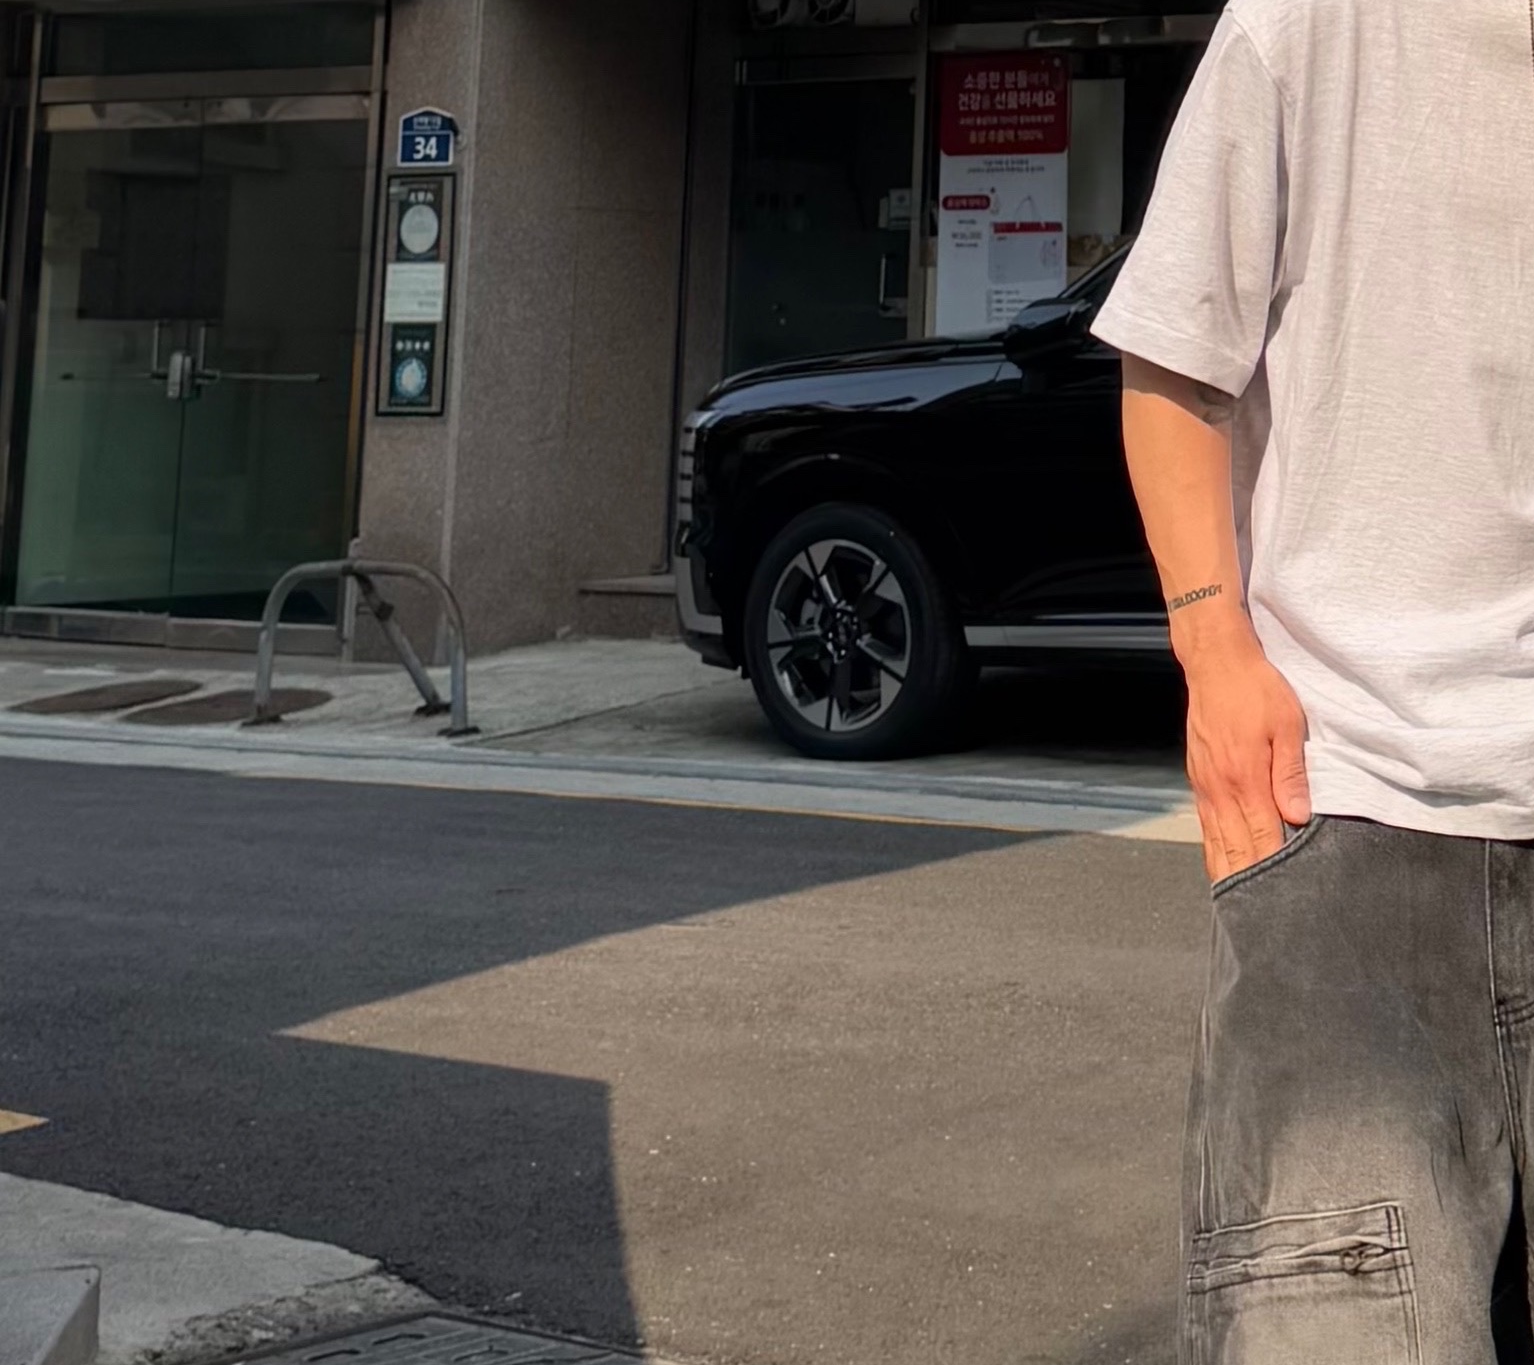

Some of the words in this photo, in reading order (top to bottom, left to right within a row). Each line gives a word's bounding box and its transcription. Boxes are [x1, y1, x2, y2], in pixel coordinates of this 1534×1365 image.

[963, 70, 1000, 90] 소중한
[993, 89, 1057, 111] 선물하세요
[412, 135, 438, 160] 34
